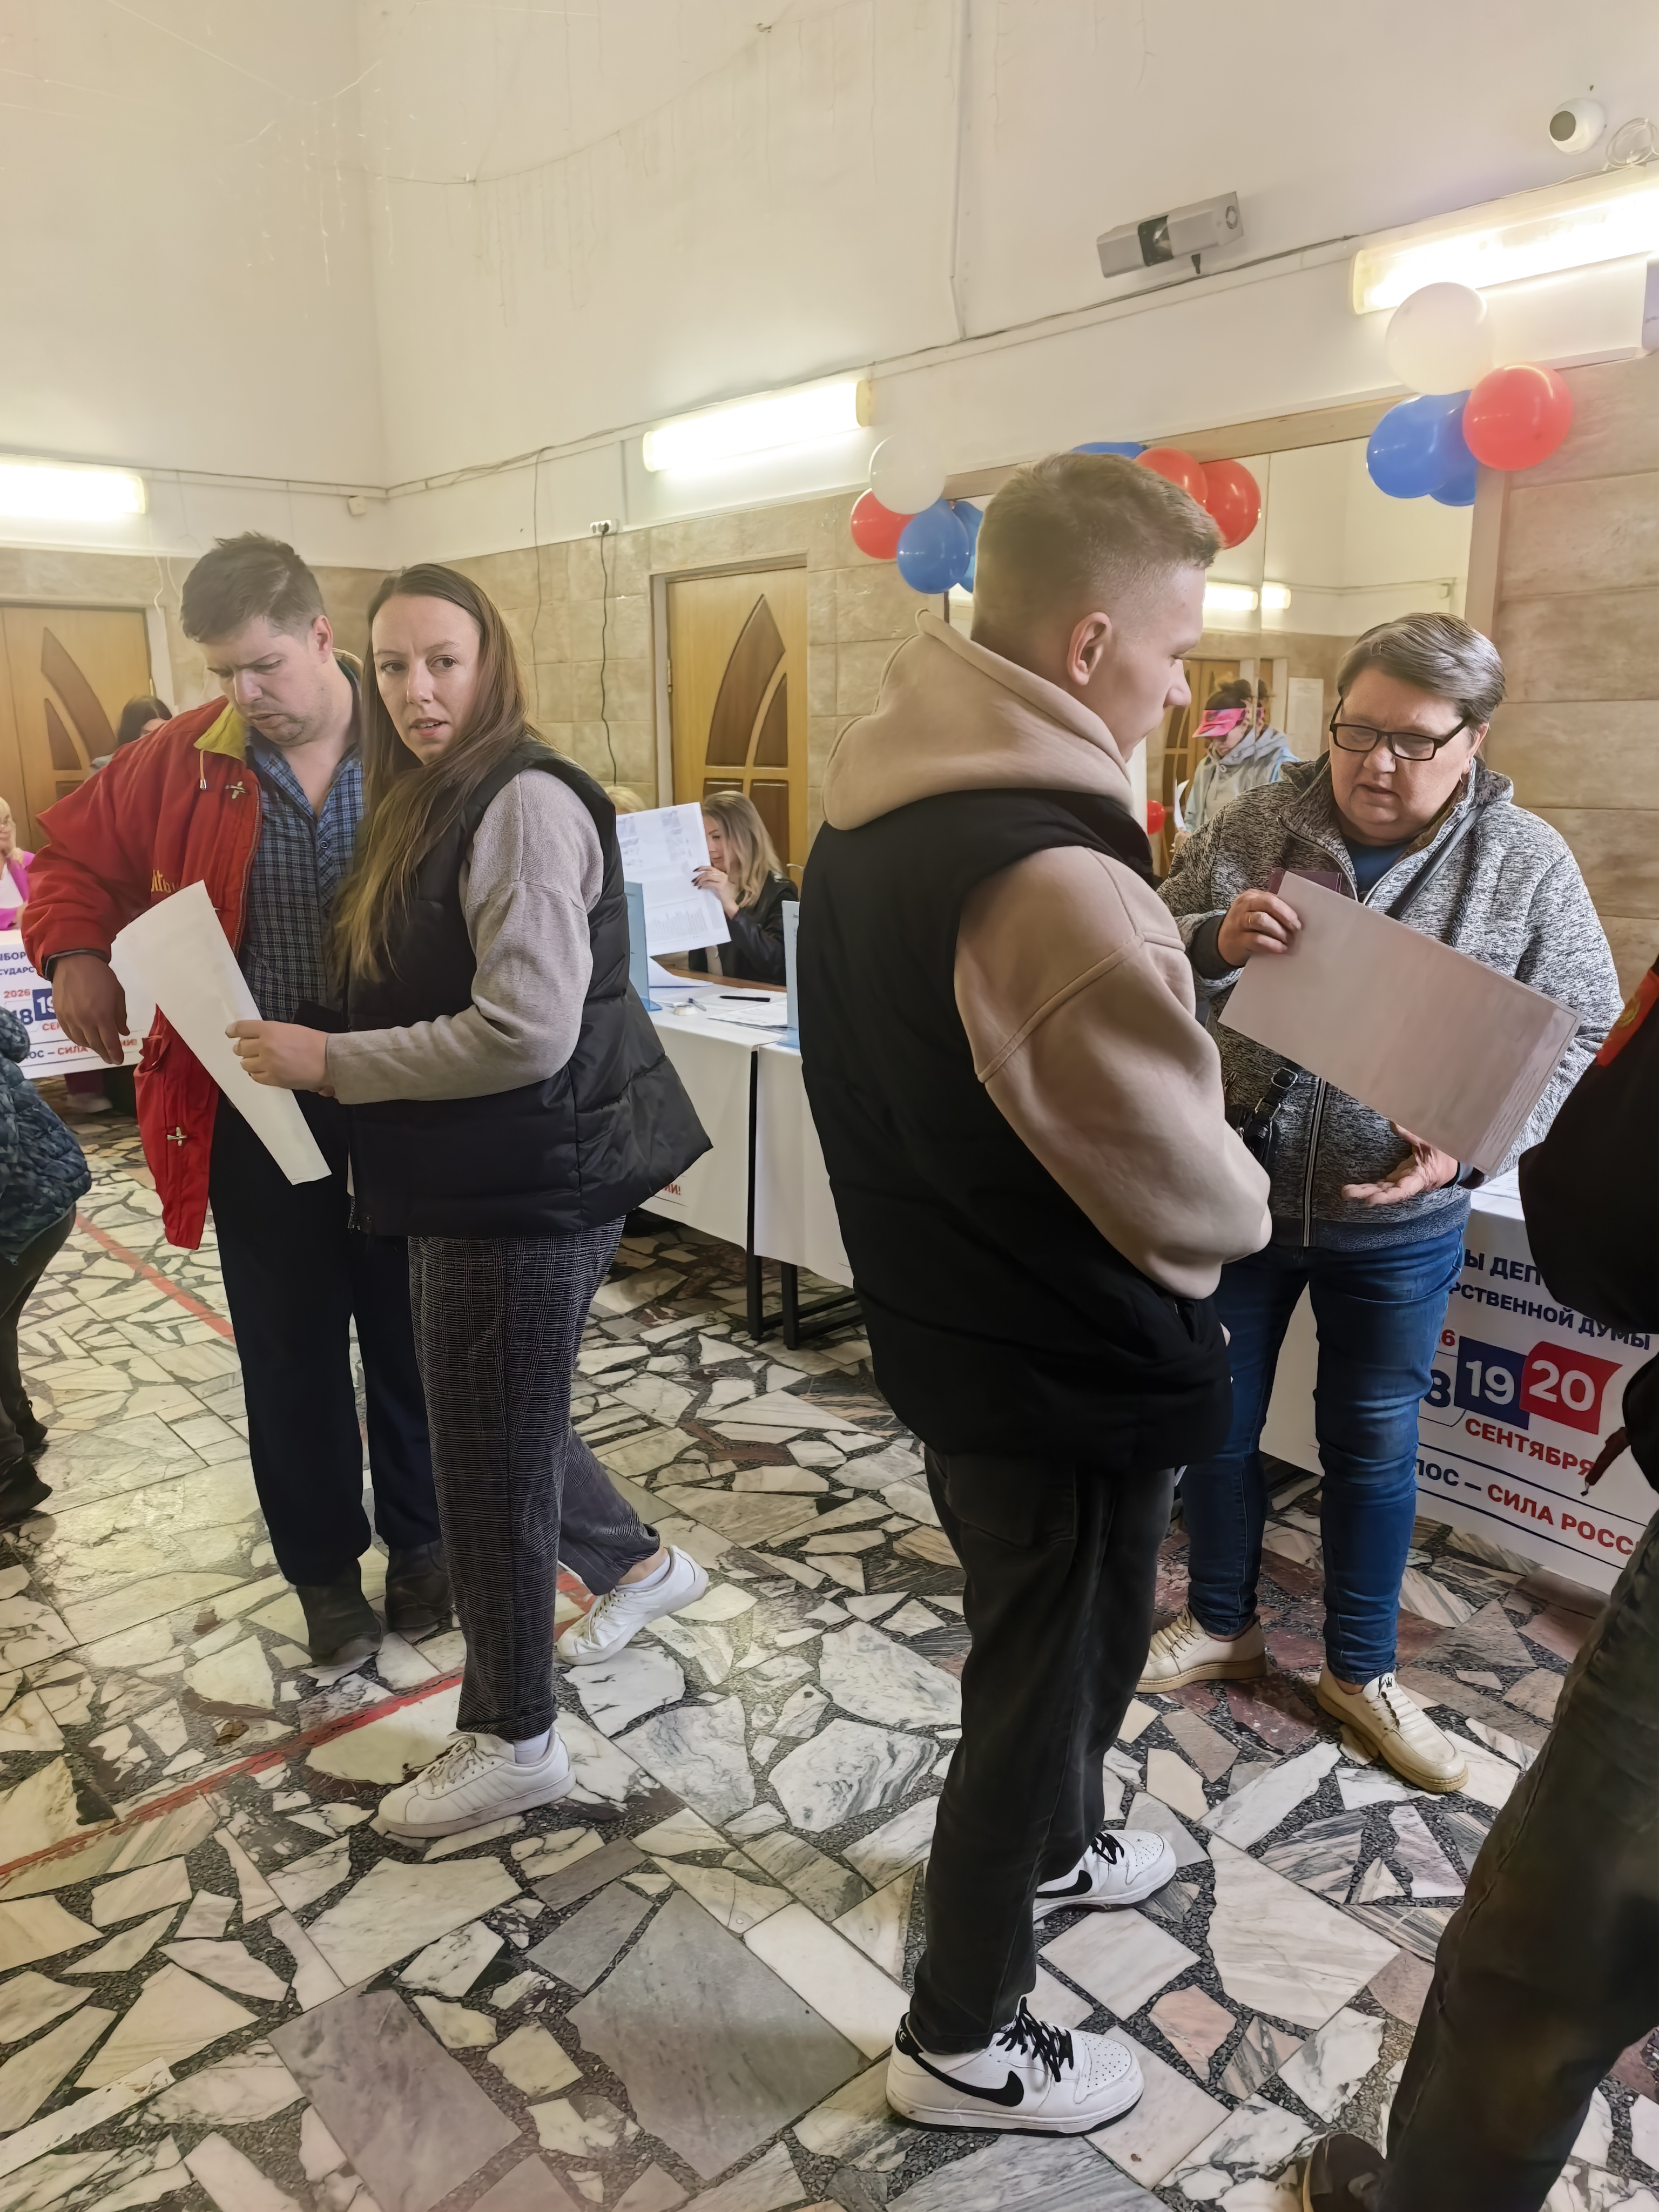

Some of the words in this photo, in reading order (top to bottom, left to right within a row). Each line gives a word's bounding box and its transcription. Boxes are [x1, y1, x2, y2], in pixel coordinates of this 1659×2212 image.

[12, 1008, 33, 1025] 8
[1439, 1329, 1455, 1346] 6
[1465, 1360, 1515, 1405] 19
[1528, 1359, 1595, 1412] 20
[1465, 1418, 1595, 1476] СЕНТЯБРЯ
[1487, 1484, 1554, 1526] СИЛА
